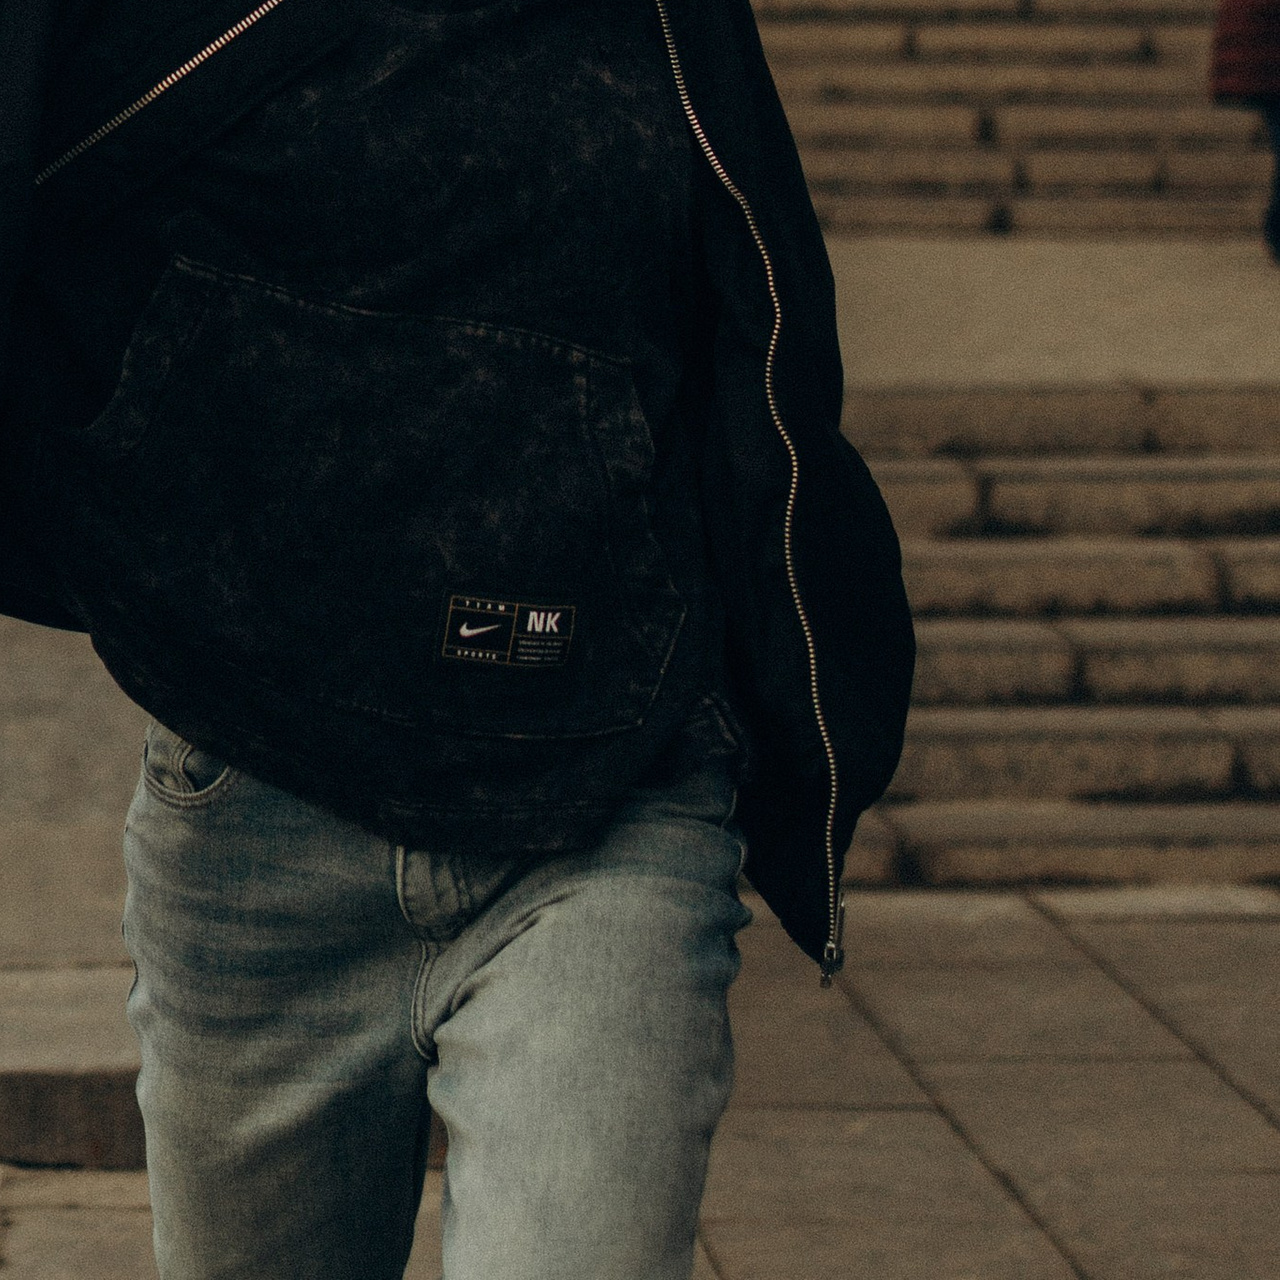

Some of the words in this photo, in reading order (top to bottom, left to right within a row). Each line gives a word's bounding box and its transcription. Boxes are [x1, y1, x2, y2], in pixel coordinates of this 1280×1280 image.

[465, 600, 506, 612] TEAM
[527, 610, 562, 633] NK
[456, 649, 498, 660] SPORTS
